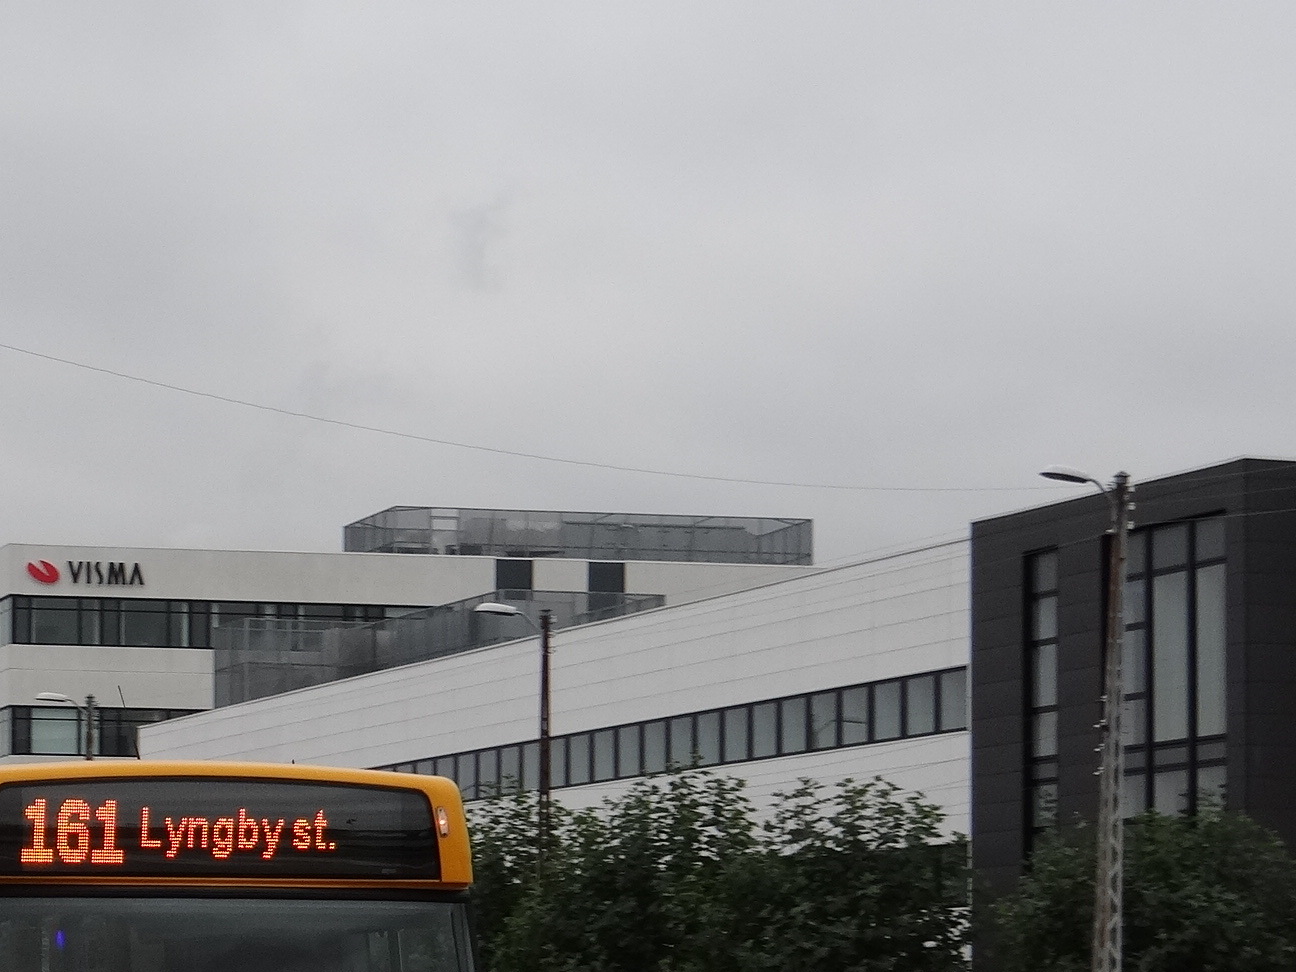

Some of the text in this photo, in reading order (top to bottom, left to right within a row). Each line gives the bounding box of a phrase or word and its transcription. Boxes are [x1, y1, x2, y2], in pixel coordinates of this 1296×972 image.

[67, 560, 145, 586] VISMA
[20, 798, 337, 864] 161 Lyngby st.
